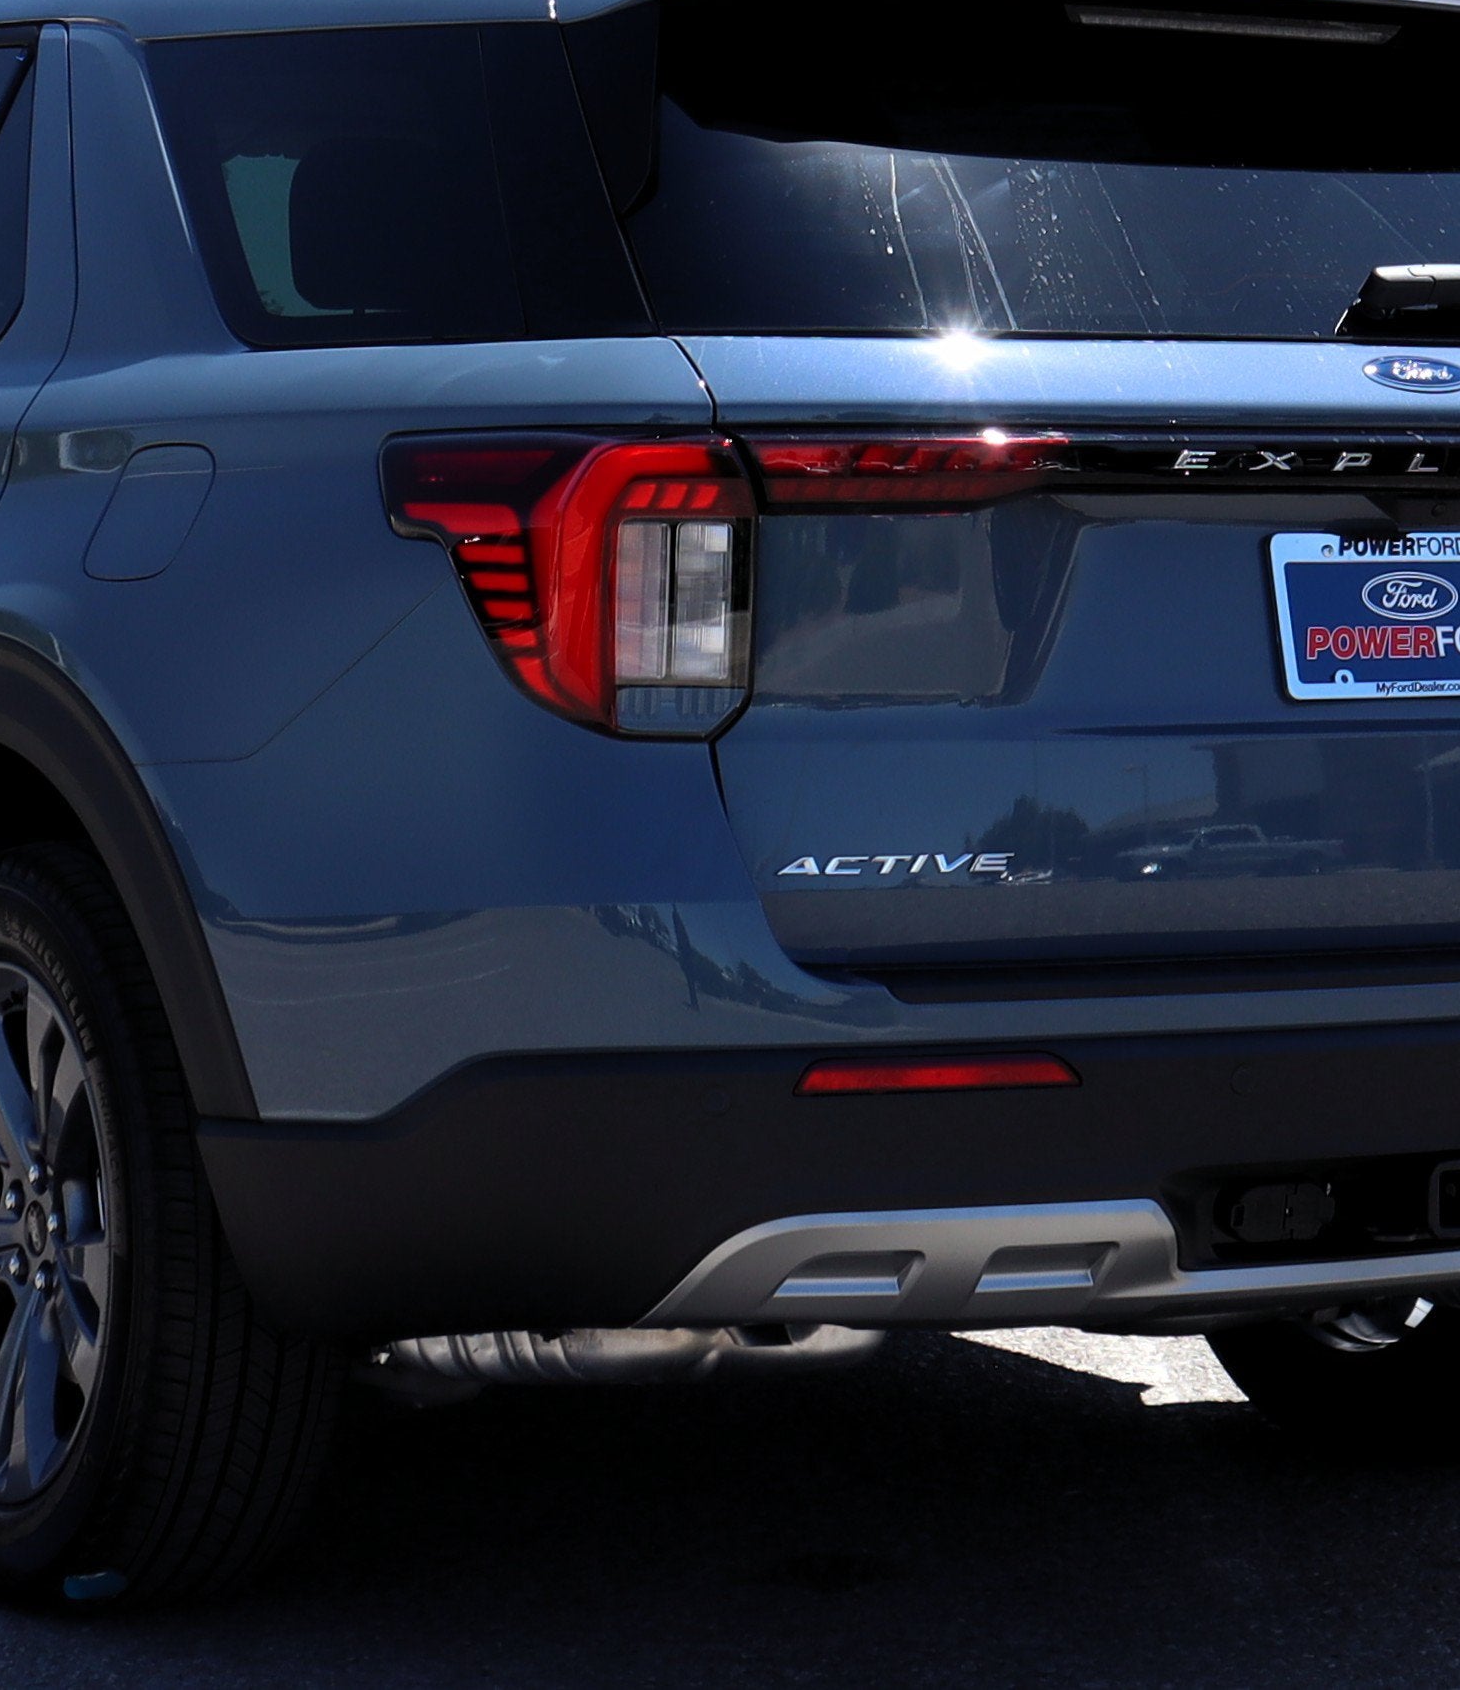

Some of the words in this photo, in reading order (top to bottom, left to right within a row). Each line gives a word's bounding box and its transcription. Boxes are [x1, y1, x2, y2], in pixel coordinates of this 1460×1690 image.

[1382, 579, 1438, 610] Ford
[777, 852, 1015, 875] ACTIVE
[23, 923, 95, 1054] MICHELIN
